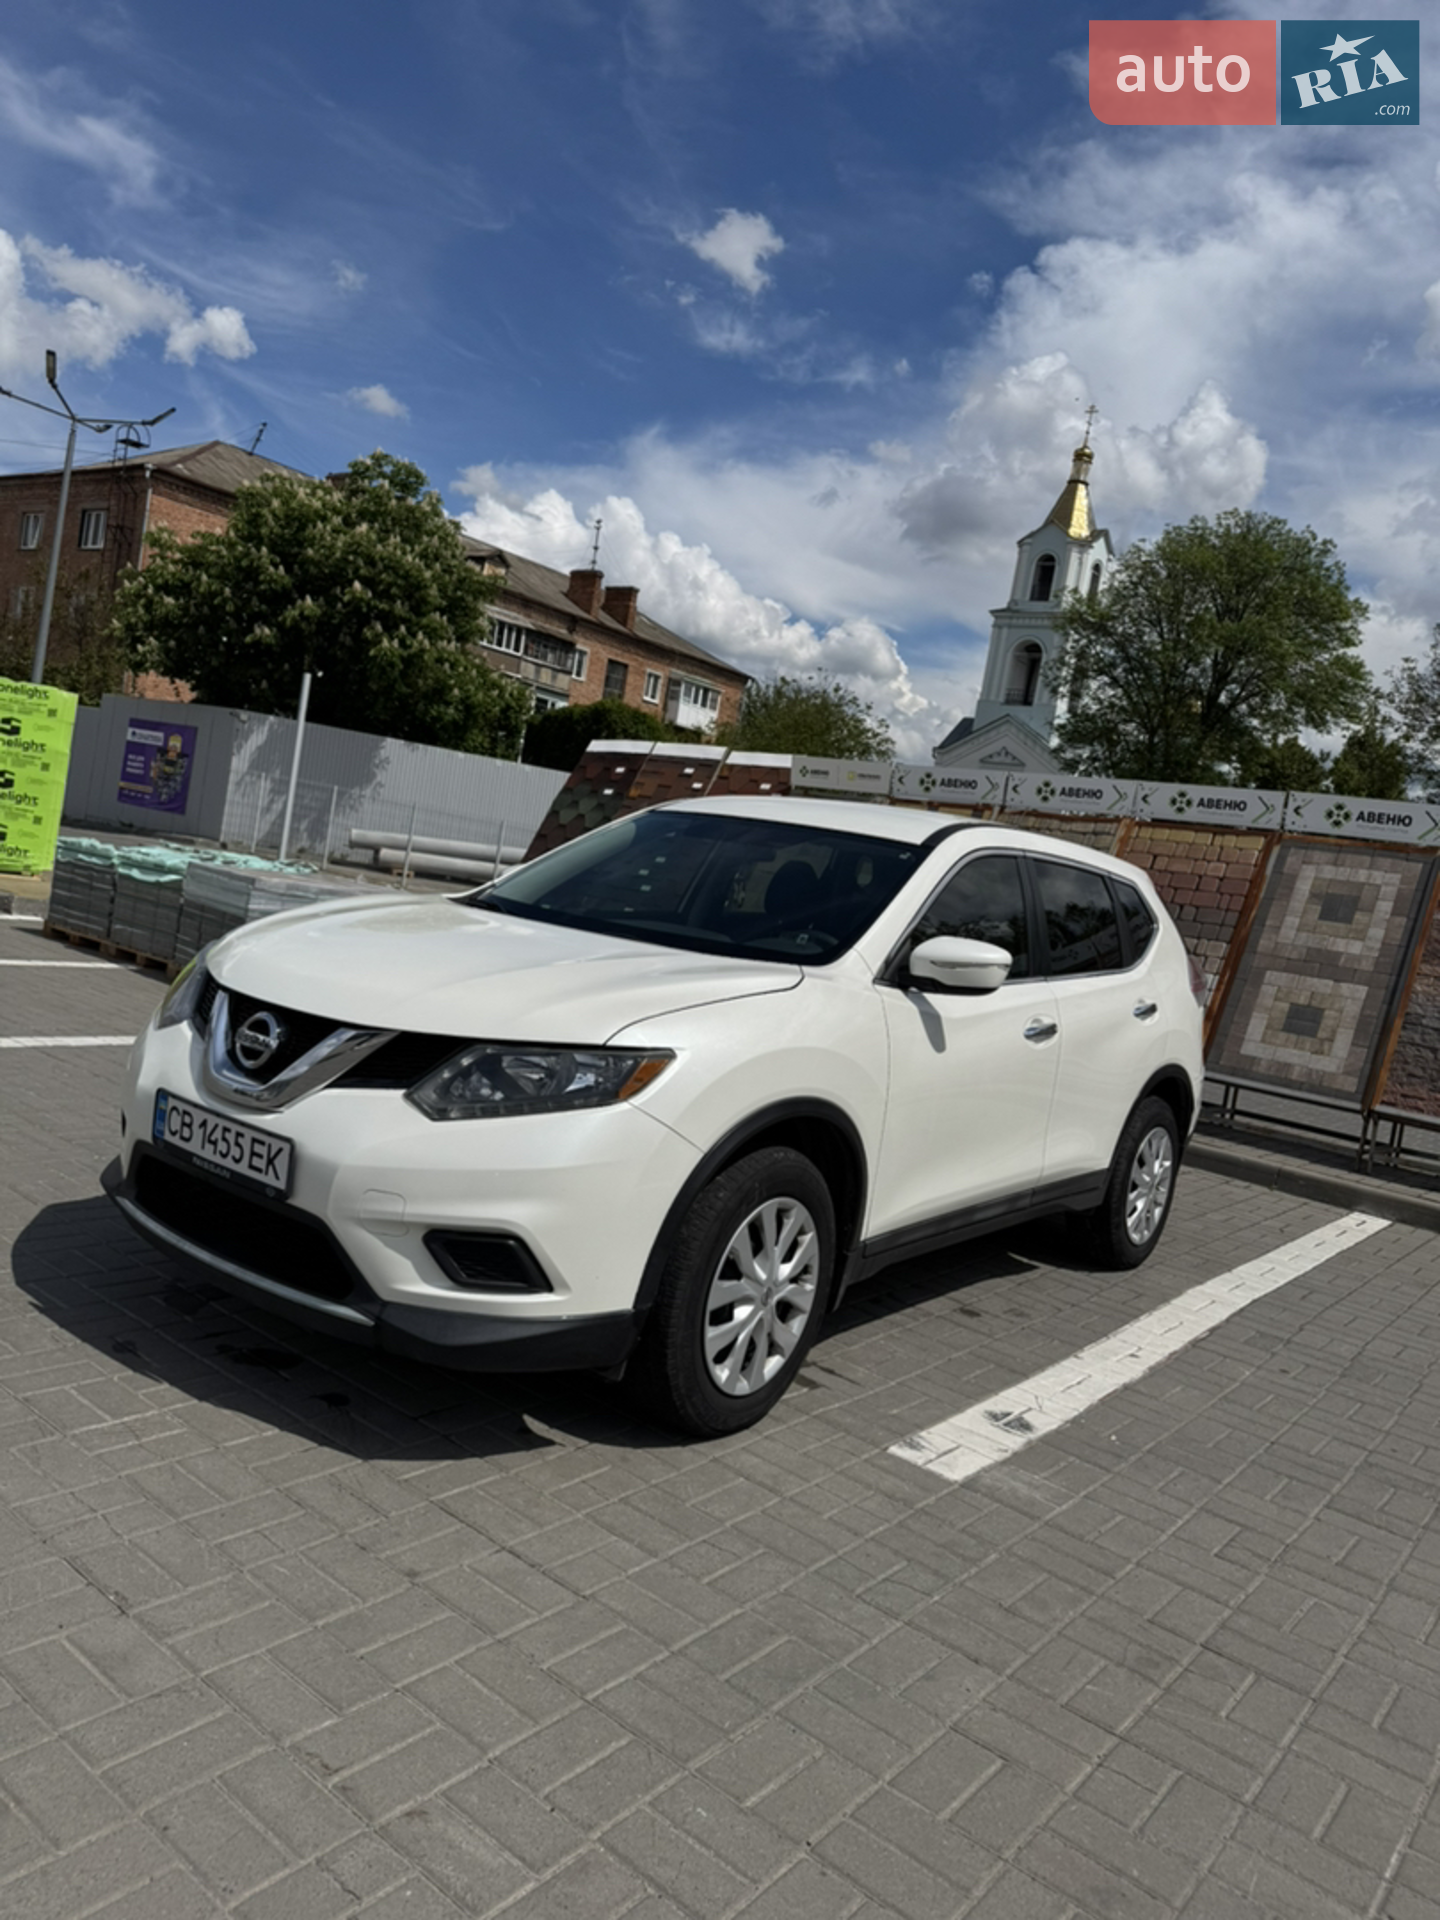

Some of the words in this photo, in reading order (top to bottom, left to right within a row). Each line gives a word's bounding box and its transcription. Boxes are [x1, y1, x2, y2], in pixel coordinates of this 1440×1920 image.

[939, 778, 978, 790] АВЕНЮ
[1059, 786, 1103, 800] АВЕНЮ
[1196, 797, 1247, 812] АВЕНЮ
[1355, 810, 1413, 827] АВЕНЮ
[168, 1105, 194, 1143] CB
[198, 1117, 244, 1164] 1455
[248, 1136, 284, 1181] EK
